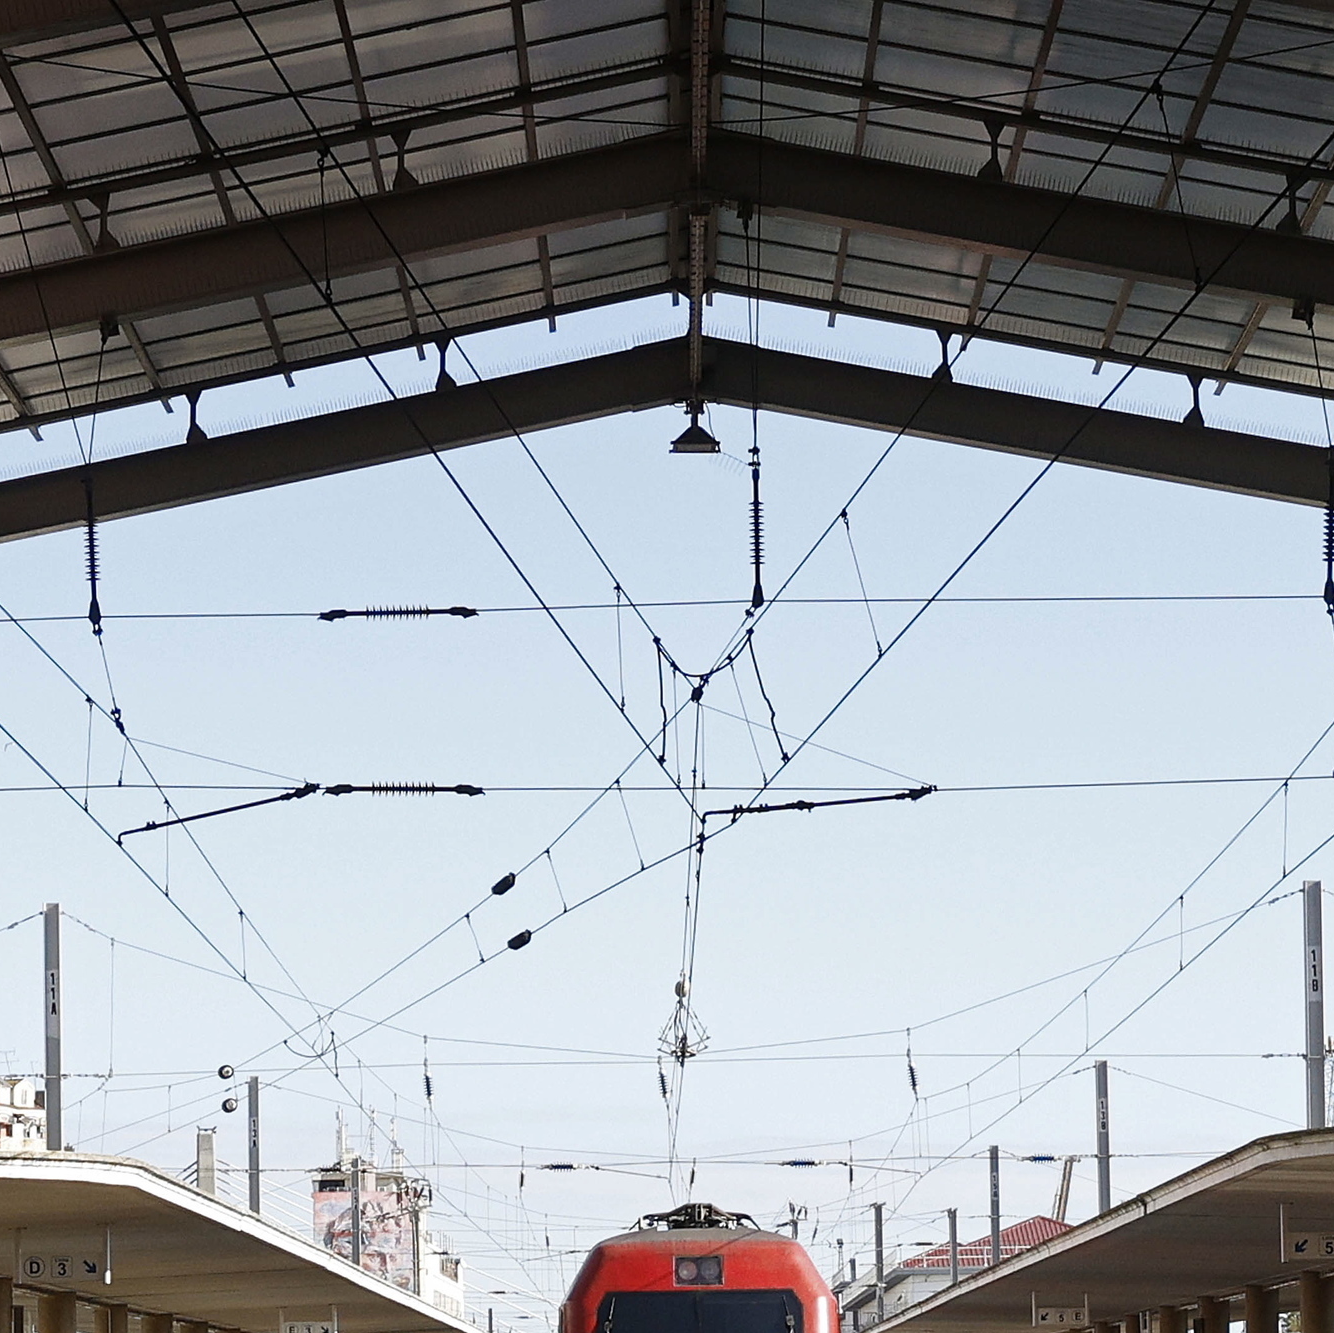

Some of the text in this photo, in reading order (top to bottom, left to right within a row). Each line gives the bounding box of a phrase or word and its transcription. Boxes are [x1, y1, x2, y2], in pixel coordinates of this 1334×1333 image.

[1325, 1242, 1334, 1254] 5
[29, 1261, 67, 1276] D 3
[1059, 1314, 1065, 1322] 5
